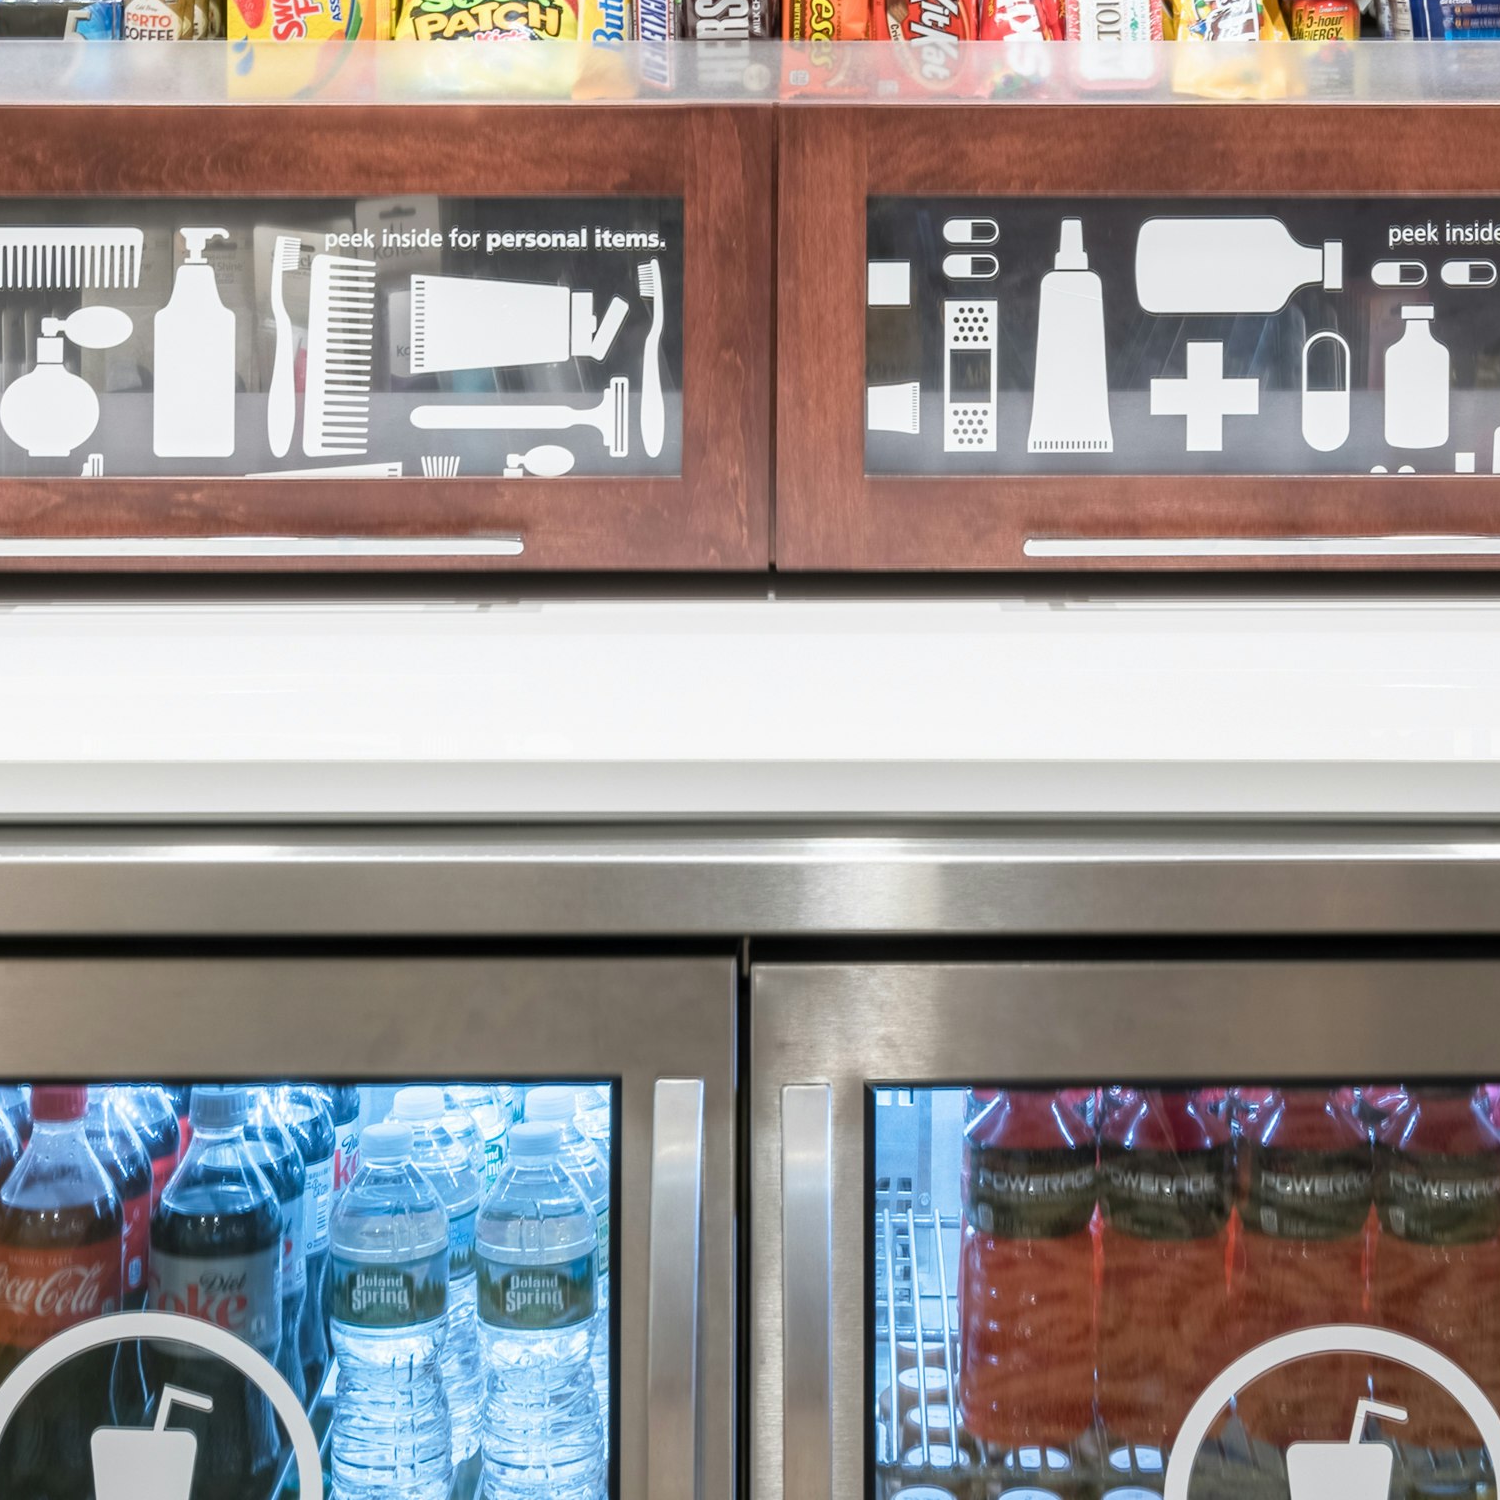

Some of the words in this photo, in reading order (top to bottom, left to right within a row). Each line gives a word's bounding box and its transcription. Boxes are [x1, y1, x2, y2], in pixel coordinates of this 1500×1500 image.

[126, 13, 172, 28] FORTO
[413, 1, 561, 41] PATCH
[750, 11, 761, 35] MILK
[1306, 8, 1345, 29] 5-hour
[125, 28, 174, 41] COFFEE
[324, 227, 375, 252] peek
[382, 227, 443, 249] inside
[448, 227, 481, 249] for
[486, 228, 588, 253] personal
[594, 228, 667, 249] items.
[1388, 221, 1439, 248] peek
[198, 1269, 247, 1293] Diet
[356, 1273, 404, 1290] Poland
[510, 1274, 558, 1290] Poland
[351, 1287, 410, 1312] Spring
[505, 1288, 564, 1313] Spring
